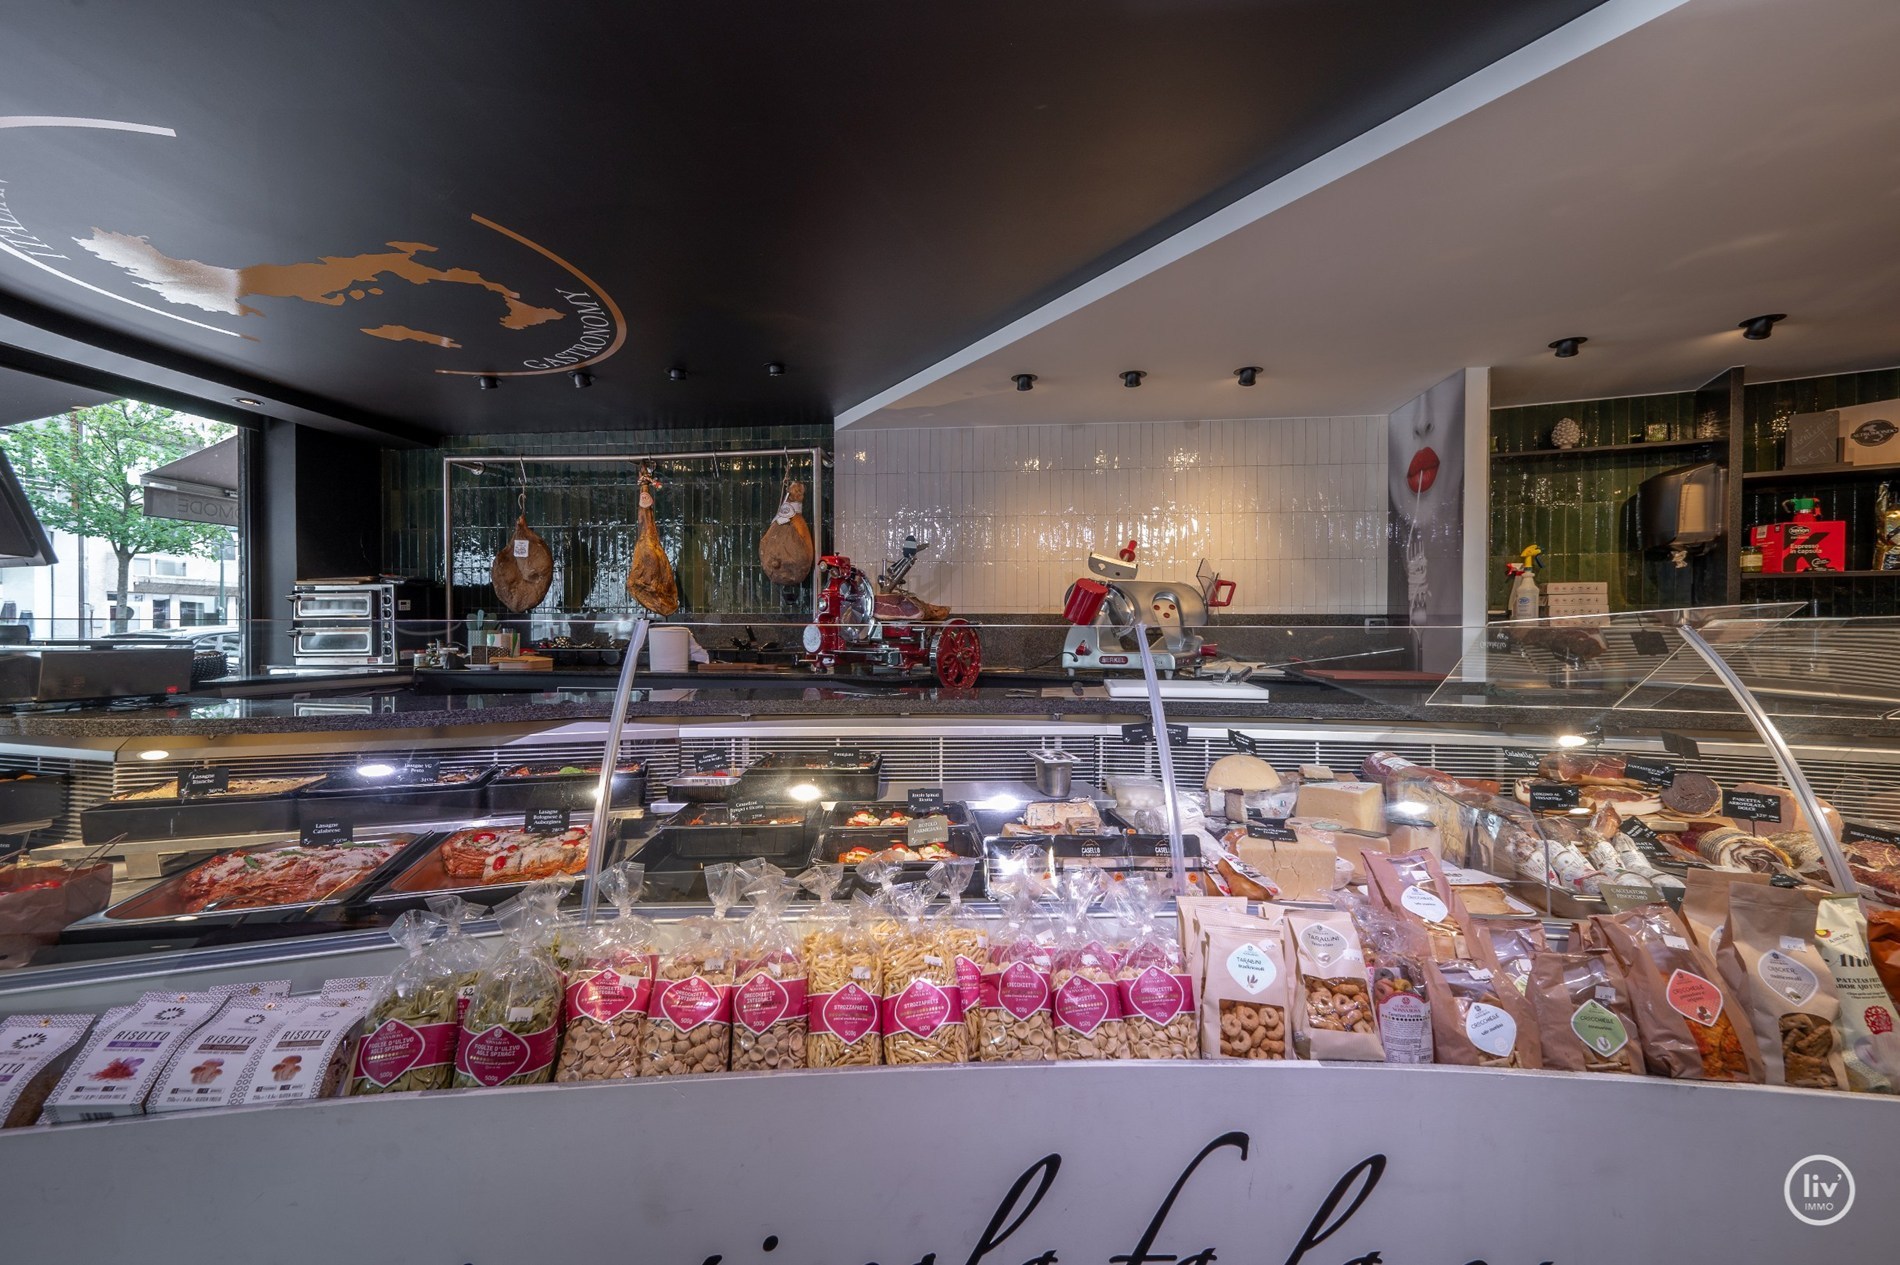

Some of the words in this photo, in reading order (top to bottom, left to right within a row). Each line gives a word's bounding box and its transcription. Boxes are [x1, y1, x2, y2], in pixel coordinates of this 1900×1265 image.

[523, 287, 611, 370] GASTRONOMY
[113, 1031, 171, 1041] RISOTTO
[203, 1035, 258, 1044] RISOTTO
[281, 1030, 331, 1040] RISOTTO
[384, 1043, 410, 1053] SPINACI
